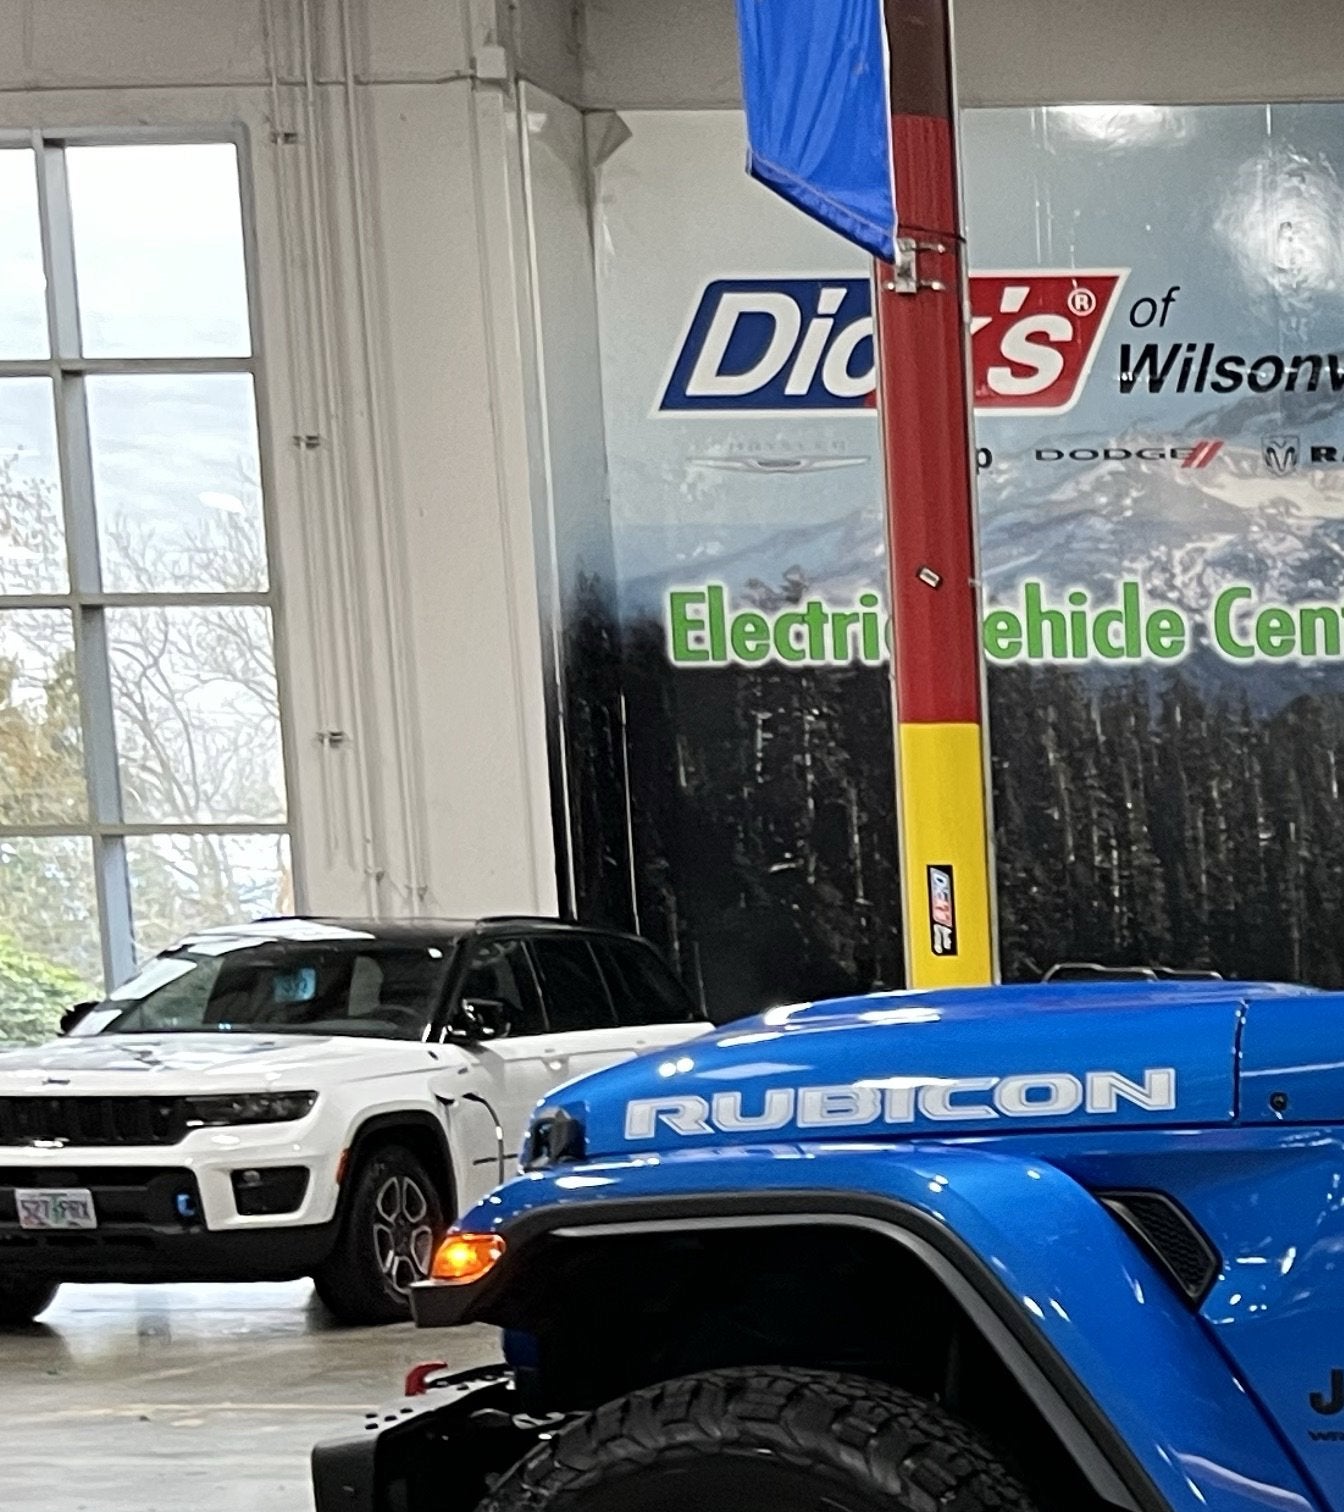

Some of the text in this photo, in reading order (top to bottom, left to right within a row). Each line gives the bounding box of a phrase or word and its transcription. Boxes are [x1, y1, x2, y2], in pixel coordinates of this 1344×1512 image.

[685, 286, 1074, 398] Dic's
[1129, 286, 1181, 328] of
[1035, 448, 1193, 462] DODGE
[669, 584, 893, 662] Electri
[984, 581, 1185, 659] ehicle
[624, 1068, 1177, 1140] RUBICON
